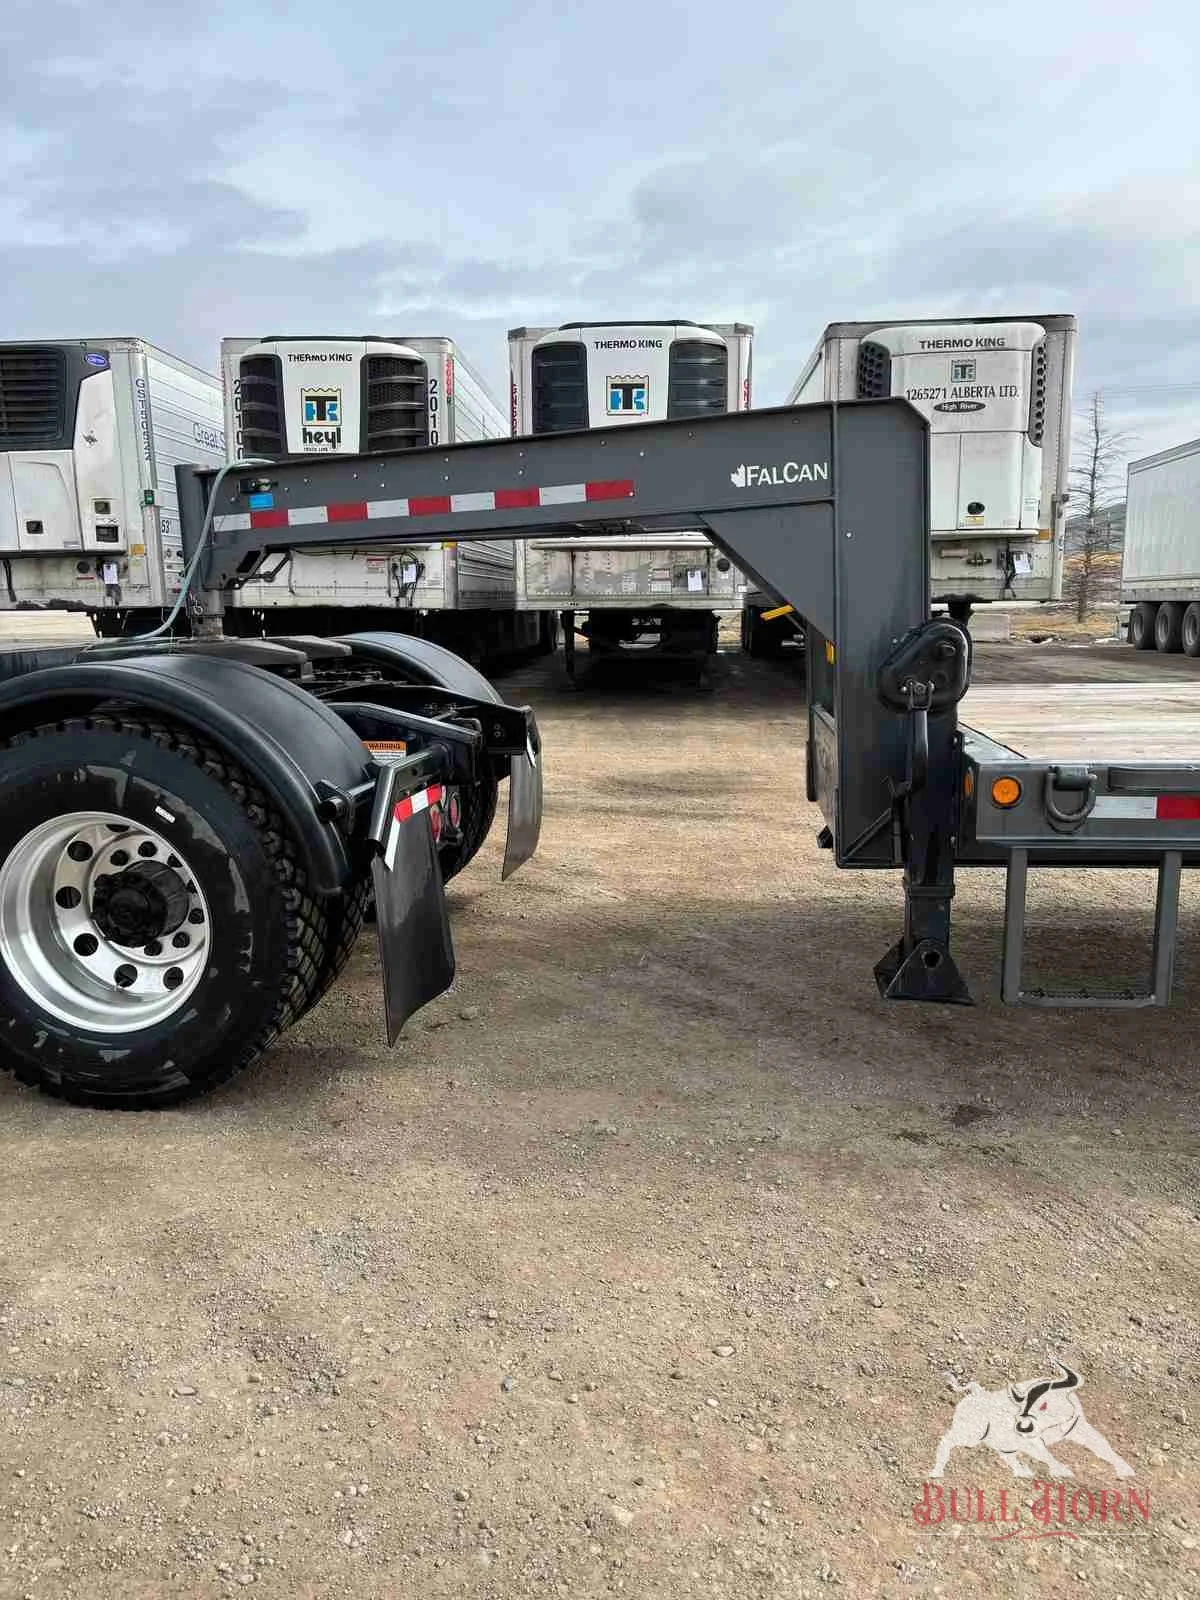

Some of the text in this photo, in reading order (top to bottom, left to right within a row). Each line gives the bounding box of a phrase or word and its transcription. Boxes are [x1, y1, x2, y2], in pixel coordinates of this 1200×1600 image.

[594, 339, 663, 349] THERMO KING
[919, 337, 1007, 349] THERMO KING
[287, 353, 353, 362] THERMO KING
[906, 385, 1020, 401] 1265271 ALBERTA LTD.
[302, 427, 342, 450] heyl
